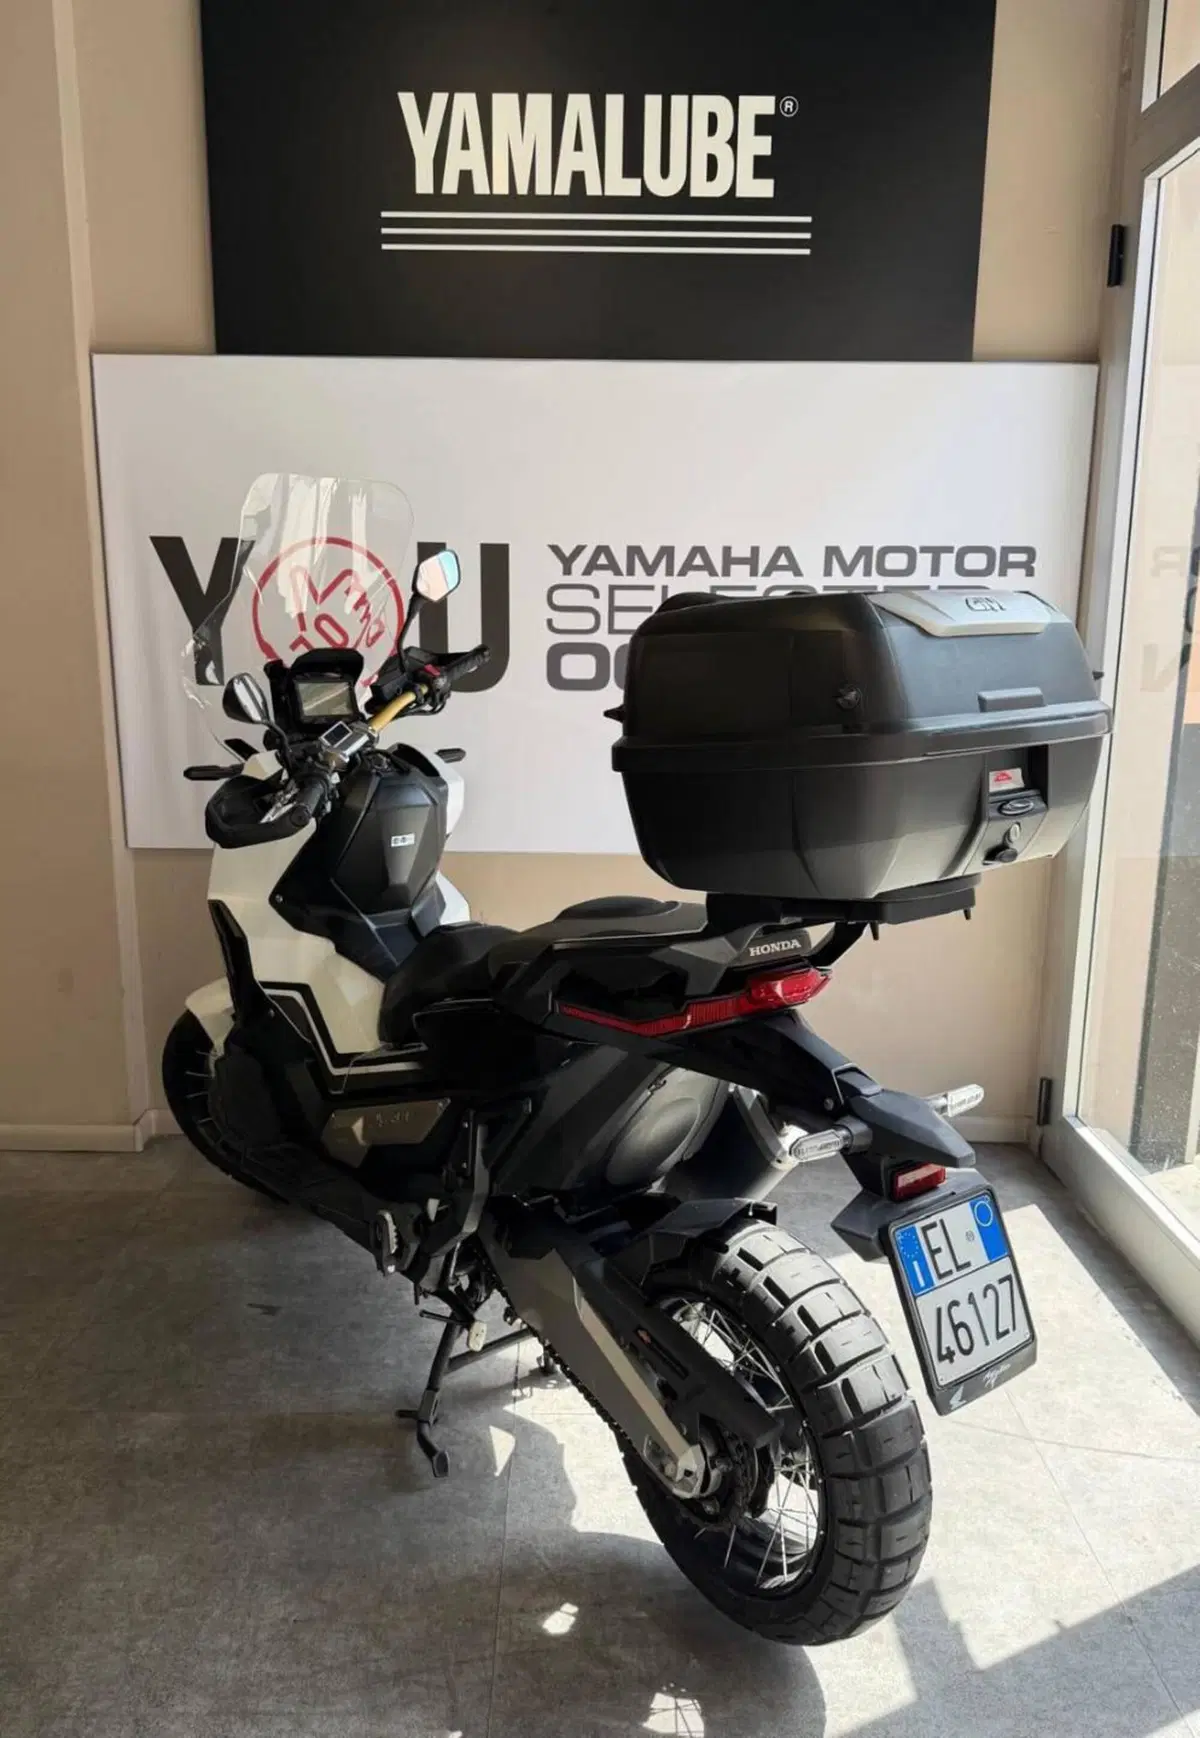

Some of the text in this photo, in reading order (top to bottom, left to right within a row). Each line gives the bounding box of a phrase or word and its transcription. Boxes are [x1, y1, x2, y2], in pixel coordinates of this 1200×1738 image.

[397, 91, 776, 198] YAMALUBE
[547, 544, 1037, 578] YAMAHA MOTOR
[749, 939, 802, 957] HONDA
[920, 1218, 972, 1280] EL
[936, 1274, 1017, 1365] 46127
